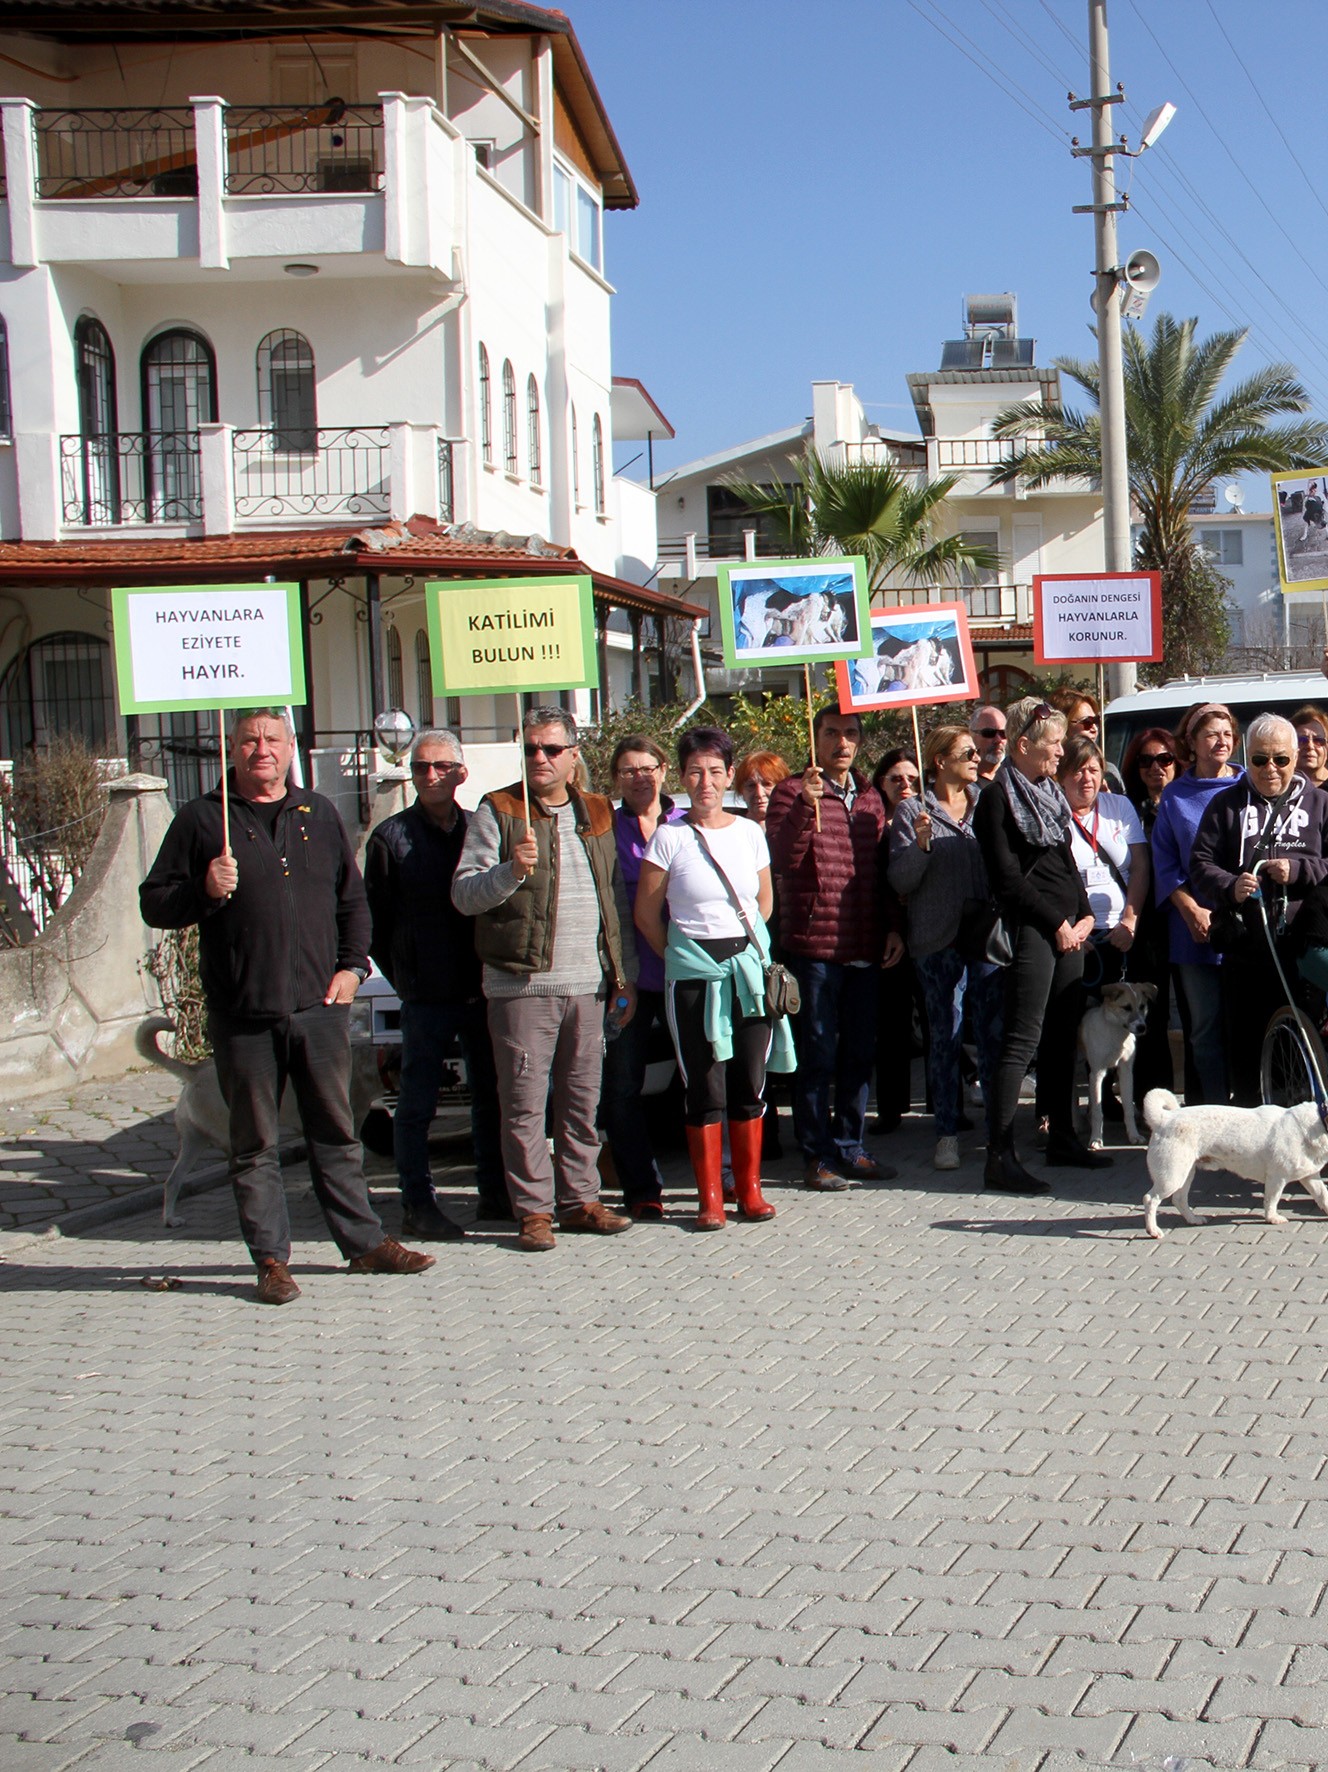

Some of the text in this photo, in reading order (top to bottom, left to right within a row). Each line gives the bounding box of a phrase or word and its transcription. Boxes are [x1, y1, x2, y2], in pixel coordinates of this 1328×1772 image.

[1053, 591, 1141, 604] DOĞANIN DENGESİ
[155, 608, 265, 623] HAYVANLARA
[468, 607, 555, 631] KATİLİMİ
[1058, 611, 1139, 622] HAYVANLARLA
[181, 634, 242, 650] EZİYETE
[1068, 631, 1128, 642] KORUNUR.
[472, 643, 561, 664] BULUN !!!
[181, 664, 245, 680] HAYIR.
